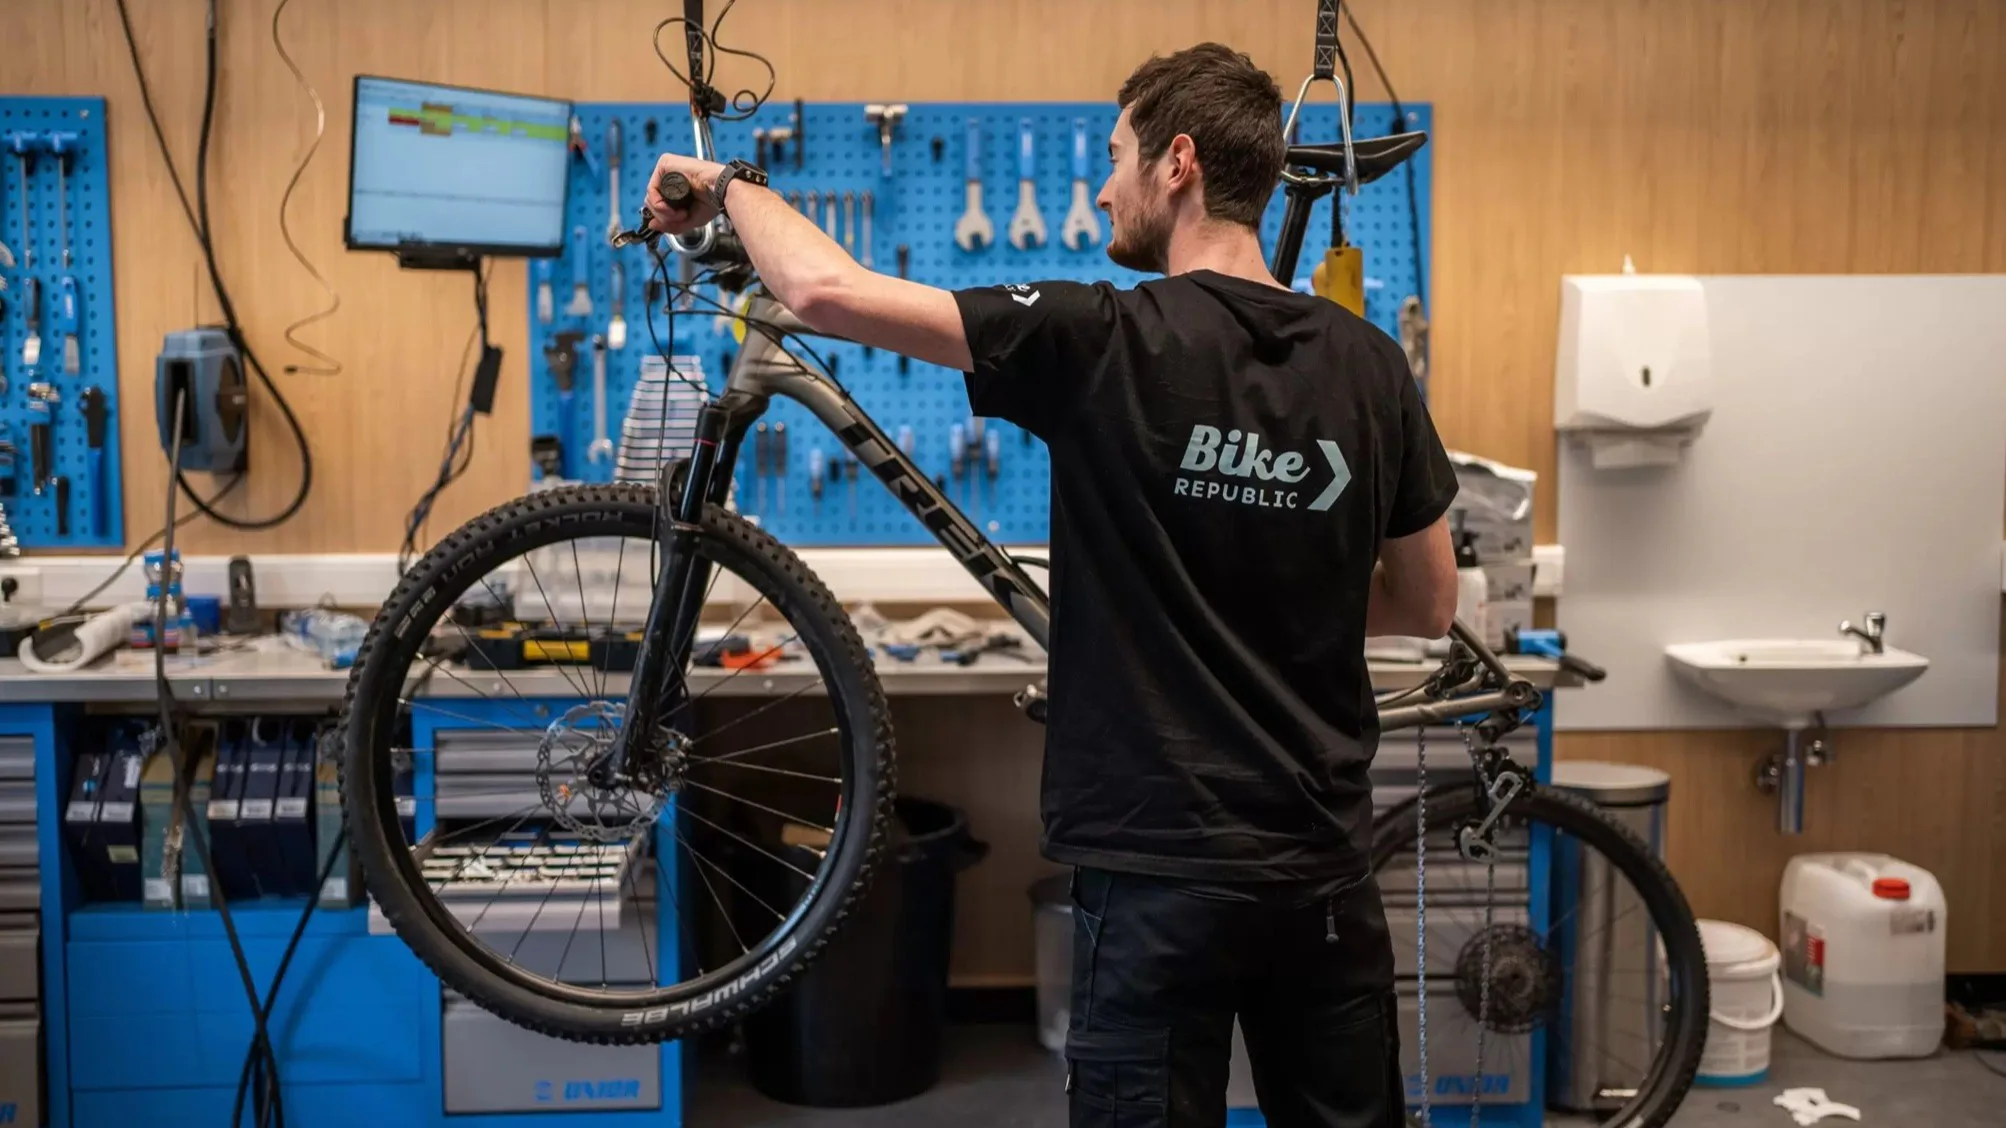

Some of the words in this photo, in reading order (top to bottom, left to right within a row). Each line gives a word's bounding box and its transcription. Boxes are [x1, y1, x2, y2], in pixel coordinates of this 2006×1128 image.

[1179, 424, 1311, 483] Bike
[839, 404, 1028, 614] TREK
[1173, 477, 1298, 509] REPUBLIC
[620, 934, 798, 1027] SCHWALBE
